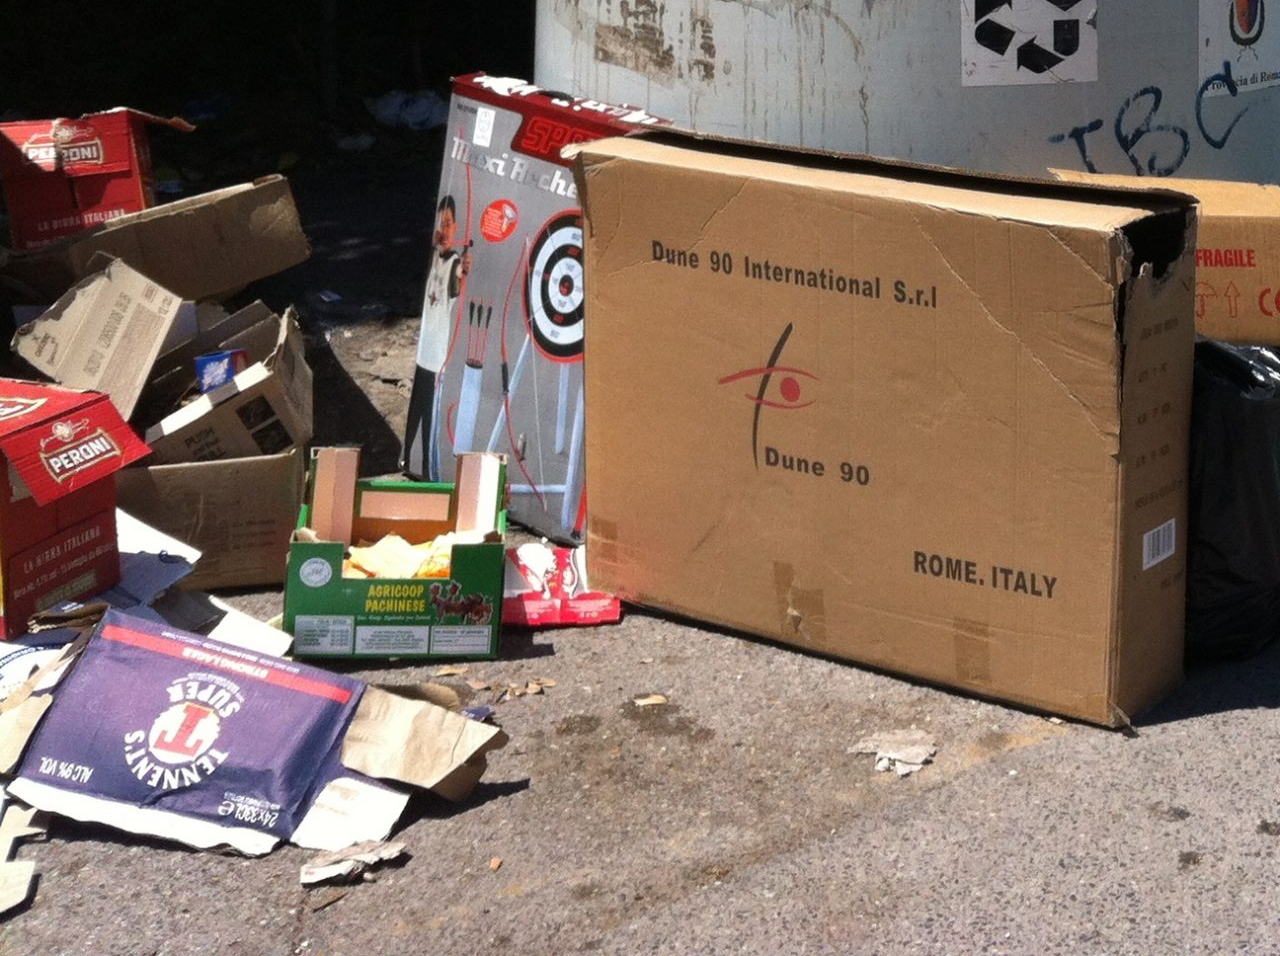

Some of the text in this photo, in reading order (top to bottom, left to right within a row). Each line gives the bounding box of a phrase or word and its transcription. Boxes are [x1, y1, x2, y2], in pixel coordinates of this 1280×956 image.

[651, 240, 700, 270] Dune
[710, 250, 733, 274] 90
[744, 256, 881, 299] International
[1195, 249, 1256, 267] FRAGILE
[48, 436, 112, 473] PERONI
[765, 446, 870, 486] Dune 90
[368, 584, 424, 597] AGRICOOP
[992, 566, 1057, 599] ITALY
[365, 599, 425, 612] PACHINESE
[166, 681, 241, 718] SUPER
[39, 756, 57, 776] VOL
[74, 765, 94, 783] ALC
[124, 730, 230, 790] TENNENT'S
